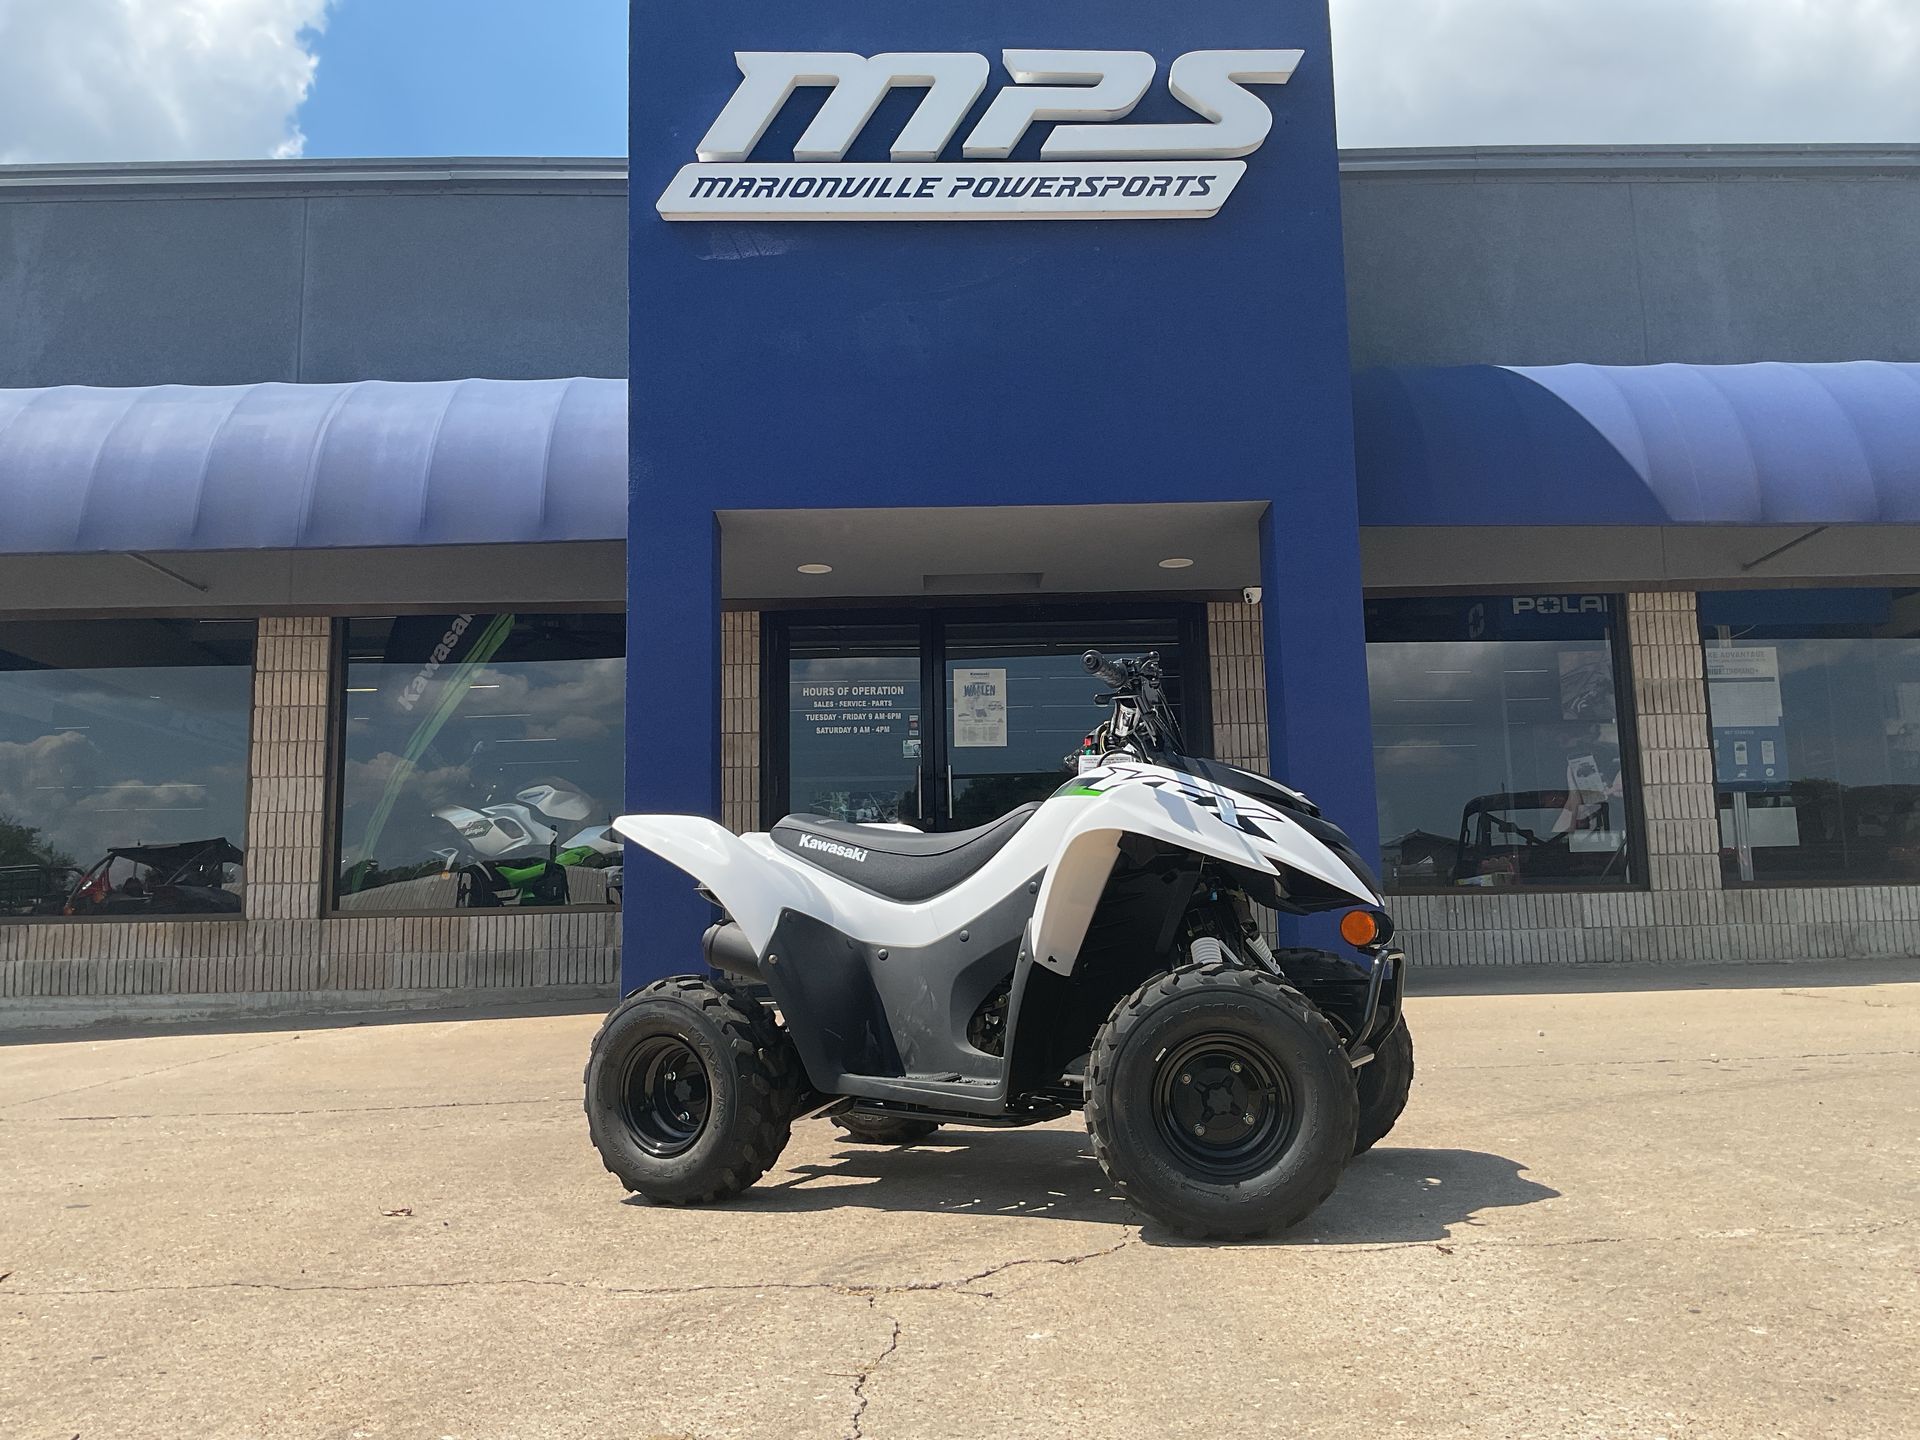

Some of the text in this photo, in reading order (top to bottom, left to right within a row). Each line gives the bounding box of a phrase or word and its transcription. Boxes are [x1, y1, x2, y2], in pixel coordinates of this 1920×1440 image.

[696, 49, 1305, 161] MPS
[689, 175, 1217, 199] MARIONVILLE POWERSPORTS
[1512, 595, 1608, 615] POLA
[802, 685, 904, 697] HOURS OF OPERATION
[871, 699, 893, 707] PARTS
[816, 726, 852, 734] SATURDAY
[799, 833, 869, 863] Kawasaki
